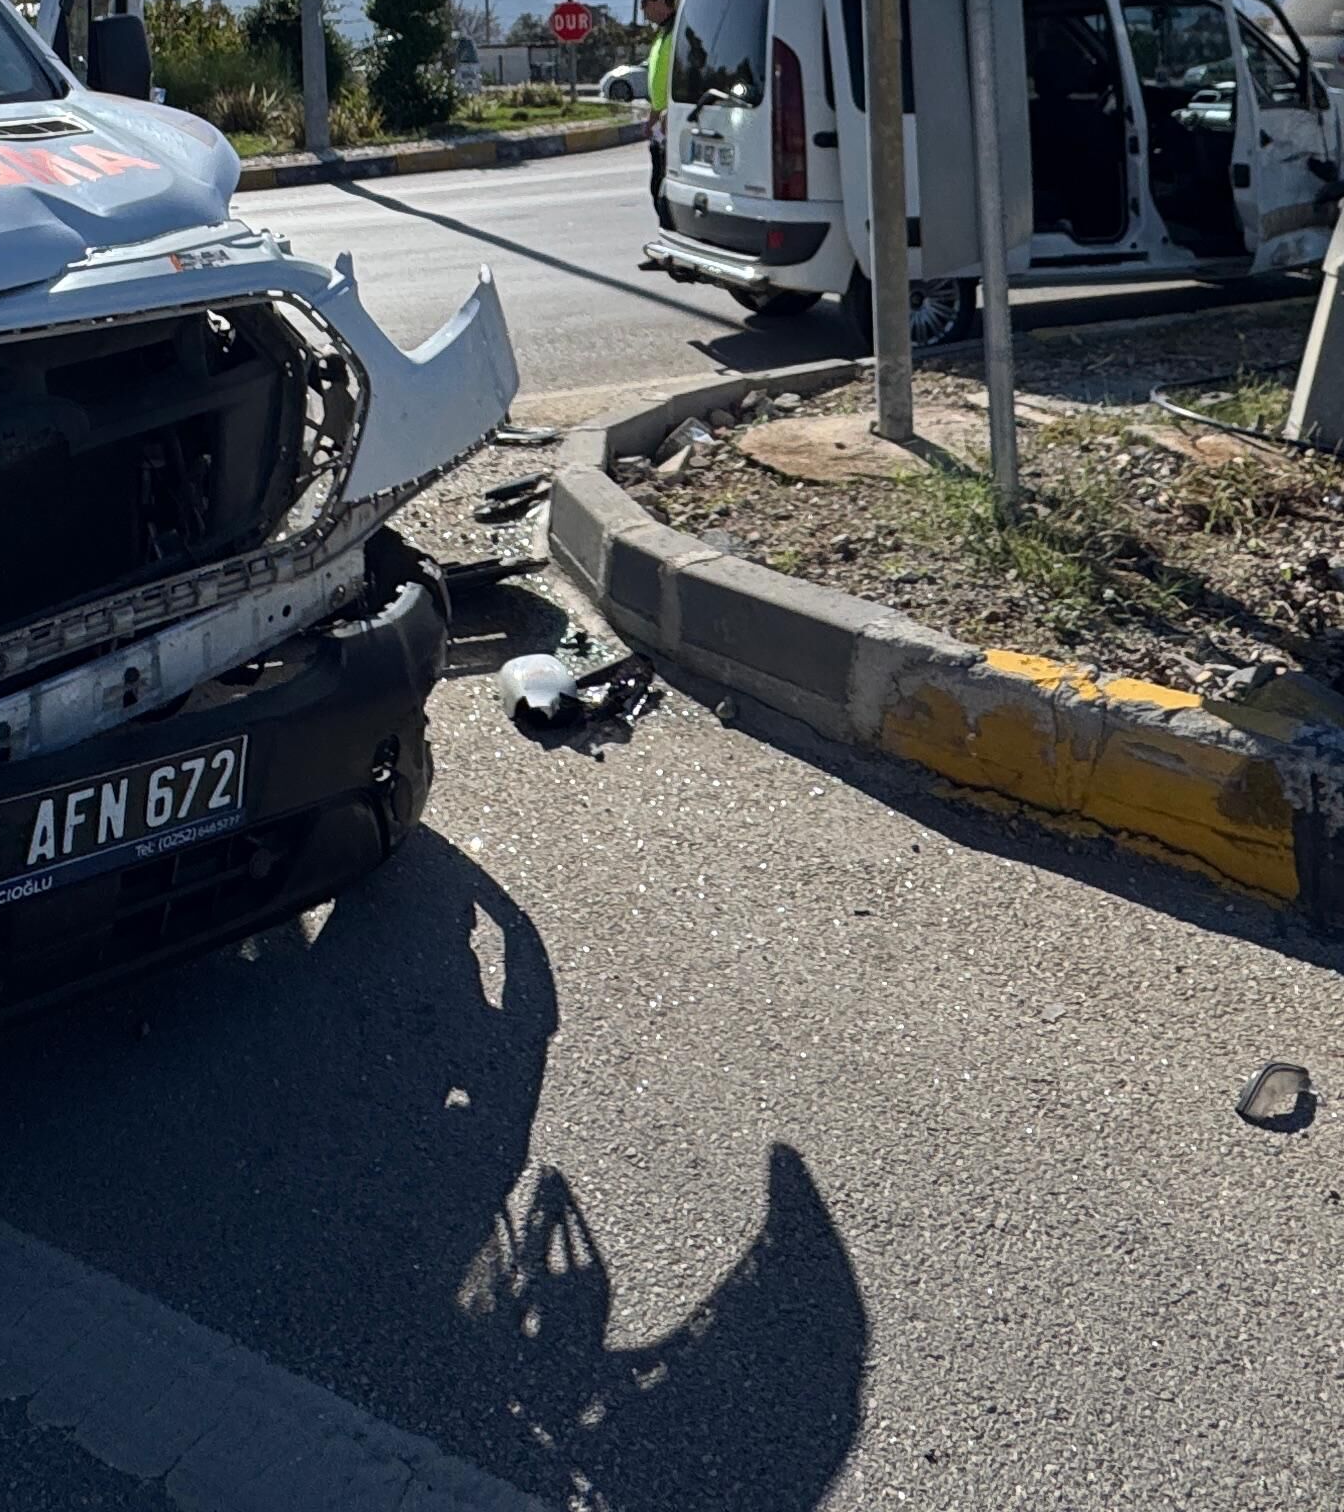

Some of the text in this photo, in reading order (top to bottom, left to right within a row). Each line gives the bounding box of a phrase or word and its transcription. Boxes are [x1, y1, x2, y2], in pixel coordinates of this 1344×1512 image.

[554, 13, 588, 32] DUR
[26, 778, 129, 866] AFN
[145, 748, 236, 829] 672
